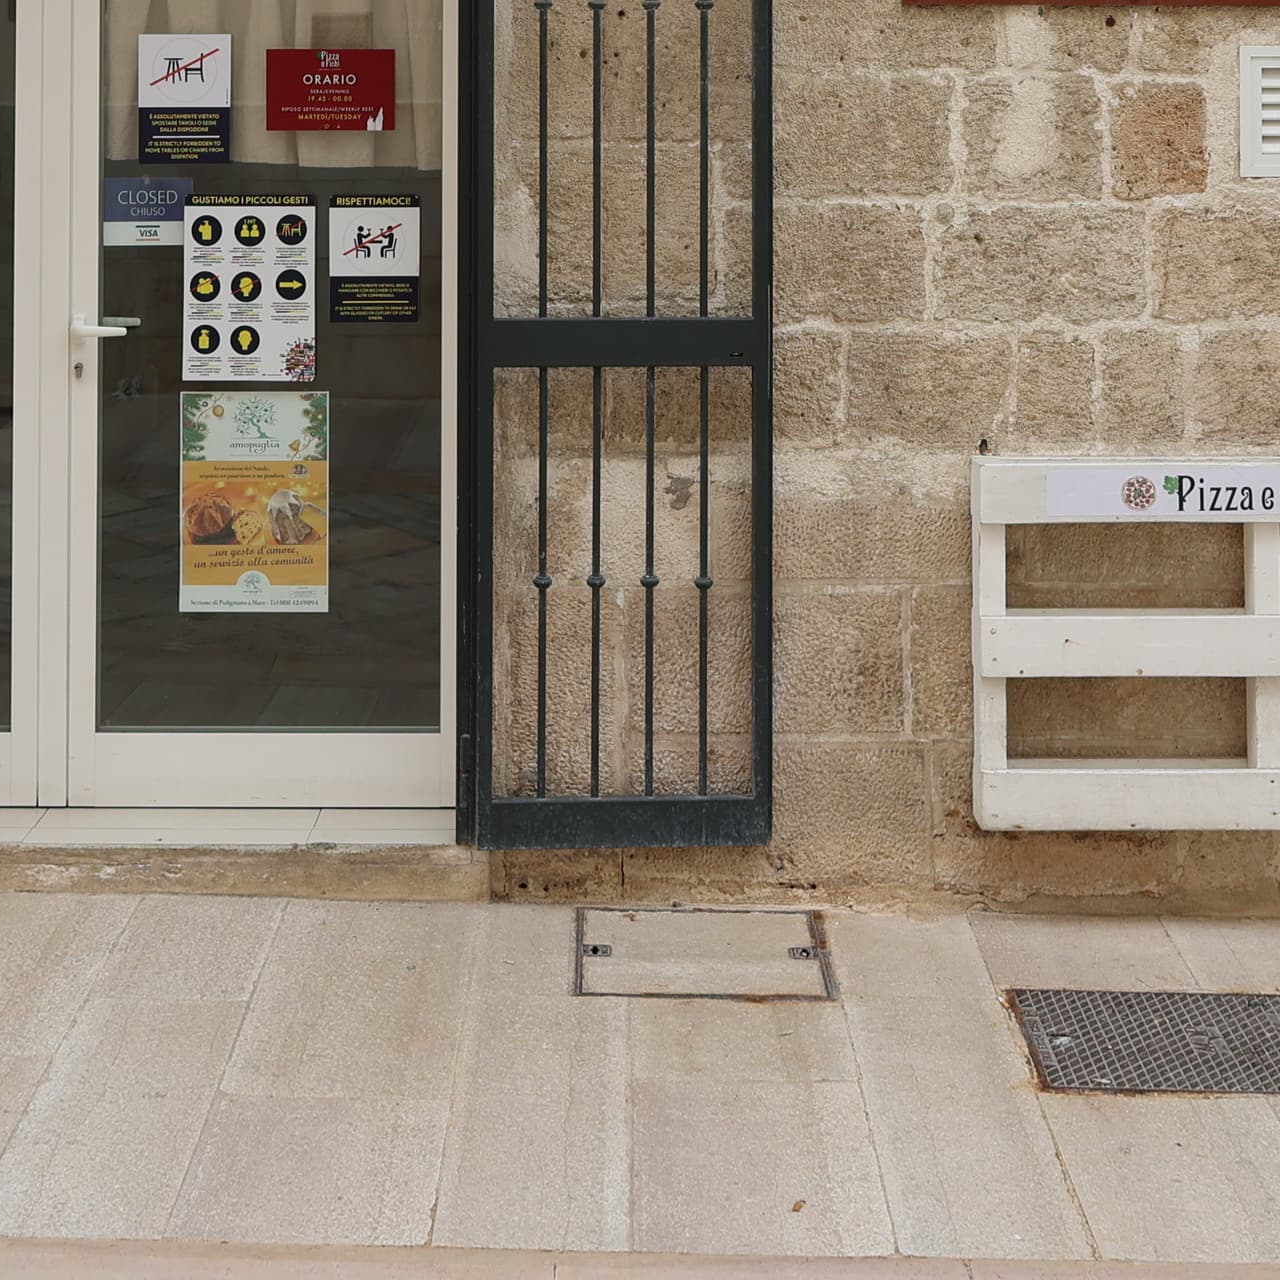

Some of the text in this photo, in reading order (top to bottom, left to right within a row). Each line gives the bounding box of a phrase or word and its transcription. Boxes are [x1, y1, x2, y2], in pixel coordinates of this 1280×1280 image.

[321, 51, 339, 60] Pizza
[302, 74, 357, 85] ORARIO
[117, 190, 178, 205] CLOSED
[192, 196, 240, 204] GUSTIAMO
[245, 196, 284, 204] PICCOLI
[285, 195, 309, 204] GESTI
[130, 207, 166, 216] CHIUSO
[139, 229, 158, 238] VISA
[229, 439, 280, 454] amopuglia
[1177, 475, 1255, 511] Pizza
[1261, 486, 1274, 510] e
[231, 548, 254, 557] gesto
[256, 546, 299, 555] d'amore,
[209, 559, 245, 568] servizio
[247, 558, 268, 566] alla
[270, 555, 314, 566] comunità
